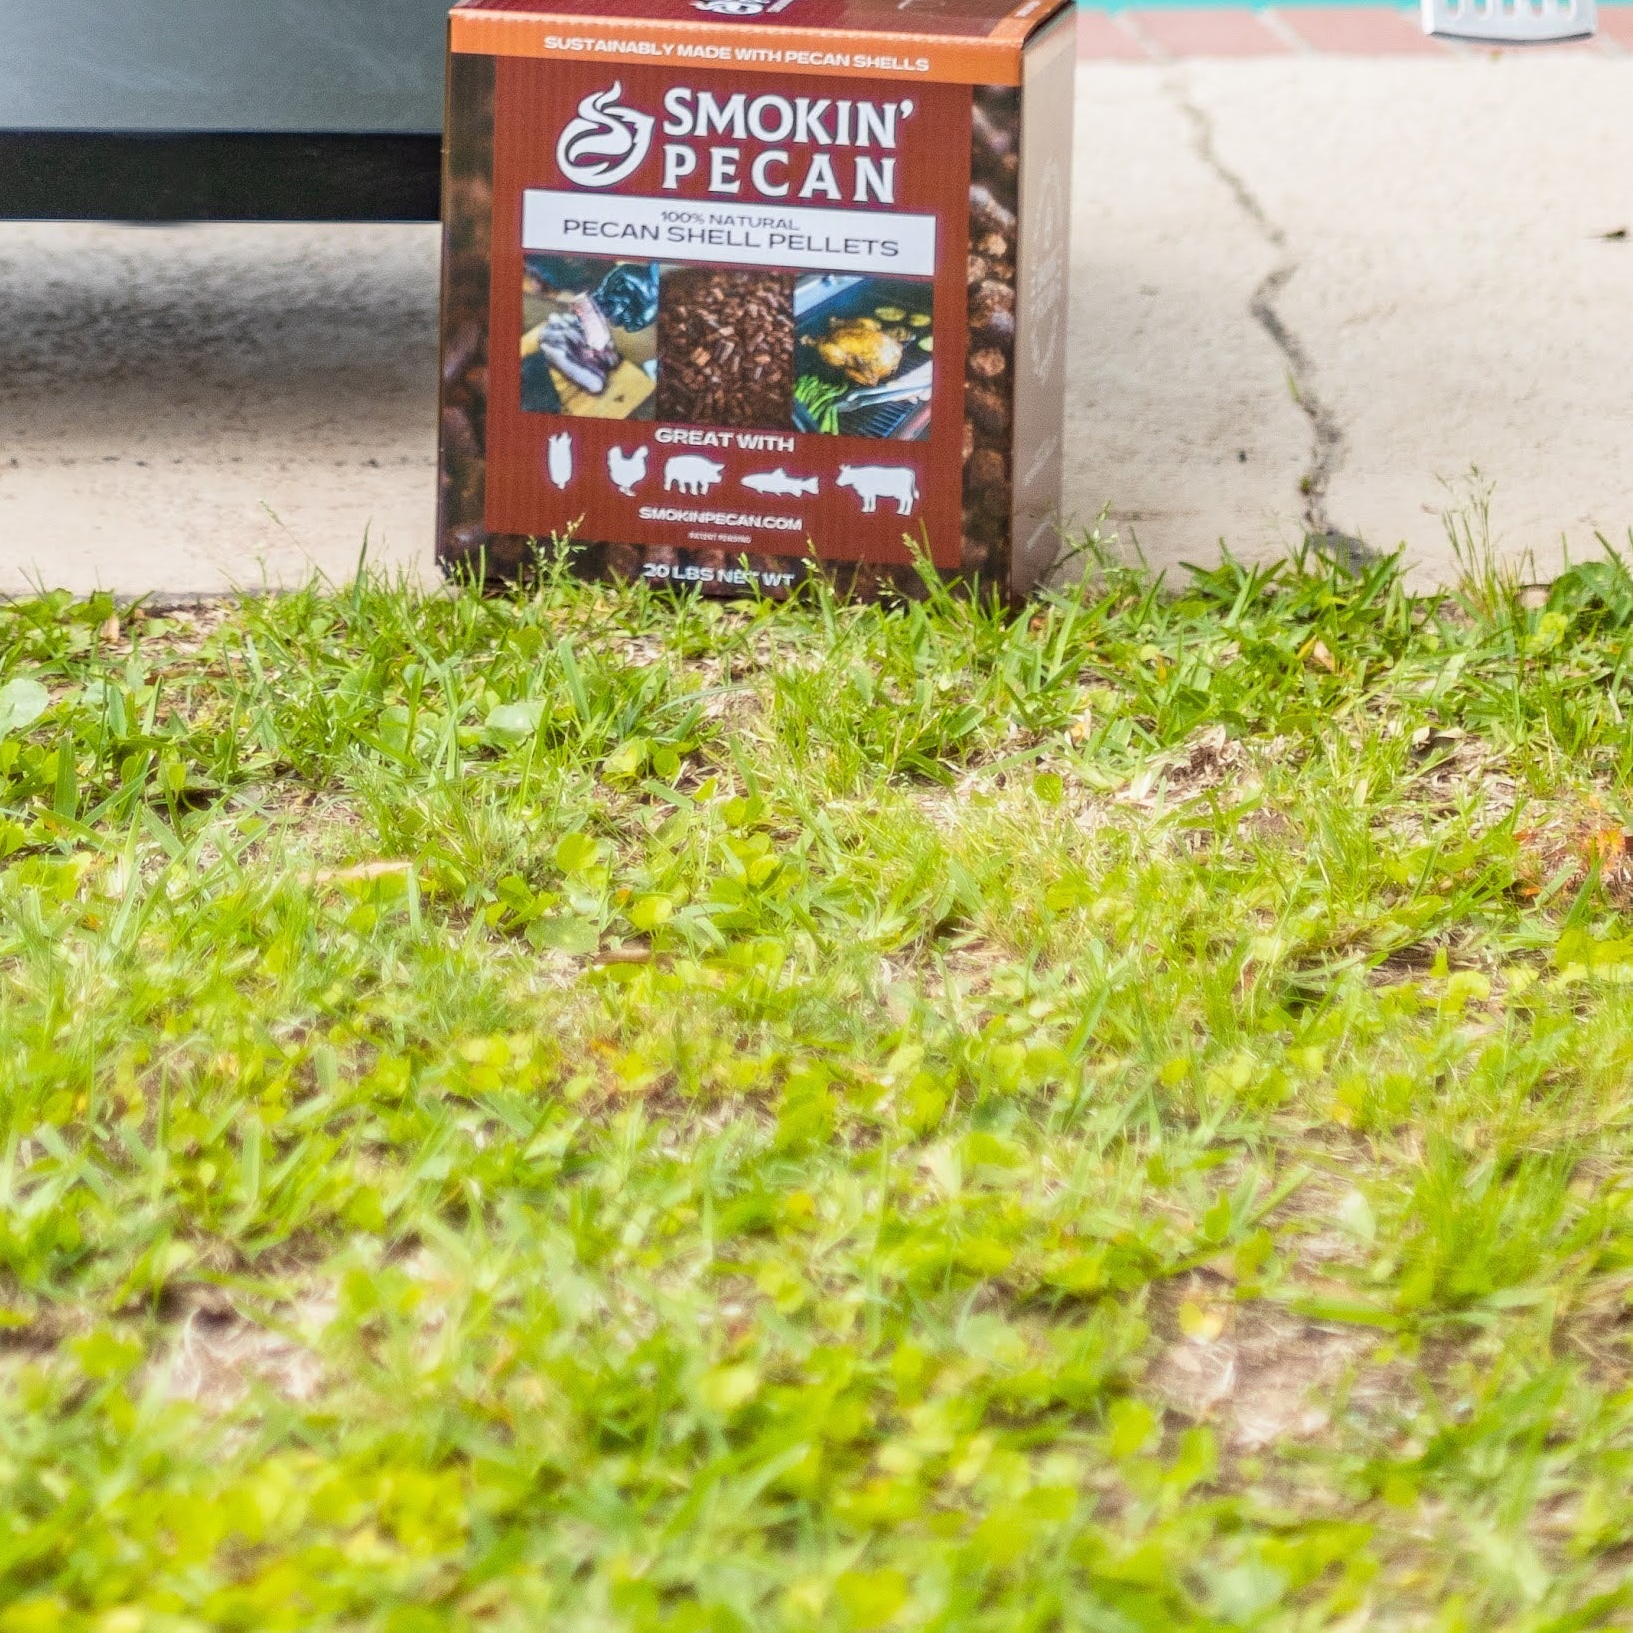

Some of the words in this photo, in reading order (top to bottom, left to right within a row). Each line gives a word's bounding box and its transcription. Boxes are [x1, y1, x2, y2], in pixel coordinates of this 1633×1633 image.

[544, 35, 674, 57] SUSTAINABLY
[676, 43, 731, 61] MADE
[734, 47, 782, 63] WITH
[785, 49, 851, 67] PECAN
[853, 53, 929, 72] SHELLS
[662, 144, 897, 204] PECAN
[661, 210, 704, 225] 100%
[709, 213, 799, 231] NATURAL
[563, 219, 660, 240] PECAN
[667, 227, 760, 248] SHELL
[769, 233, 900, 257] PELLETS
[654, 427, 735, 448] GREAT
[736, 433, 795, 452] WITH
[638, 506, 803, 531] SMOKINPECAN.COM
[688, 531, 717, 542] PATENT
[643, 563, 669, 578] 20
[671, 564, 714, 582] LBS
[761, 572, 796, 586] WT
